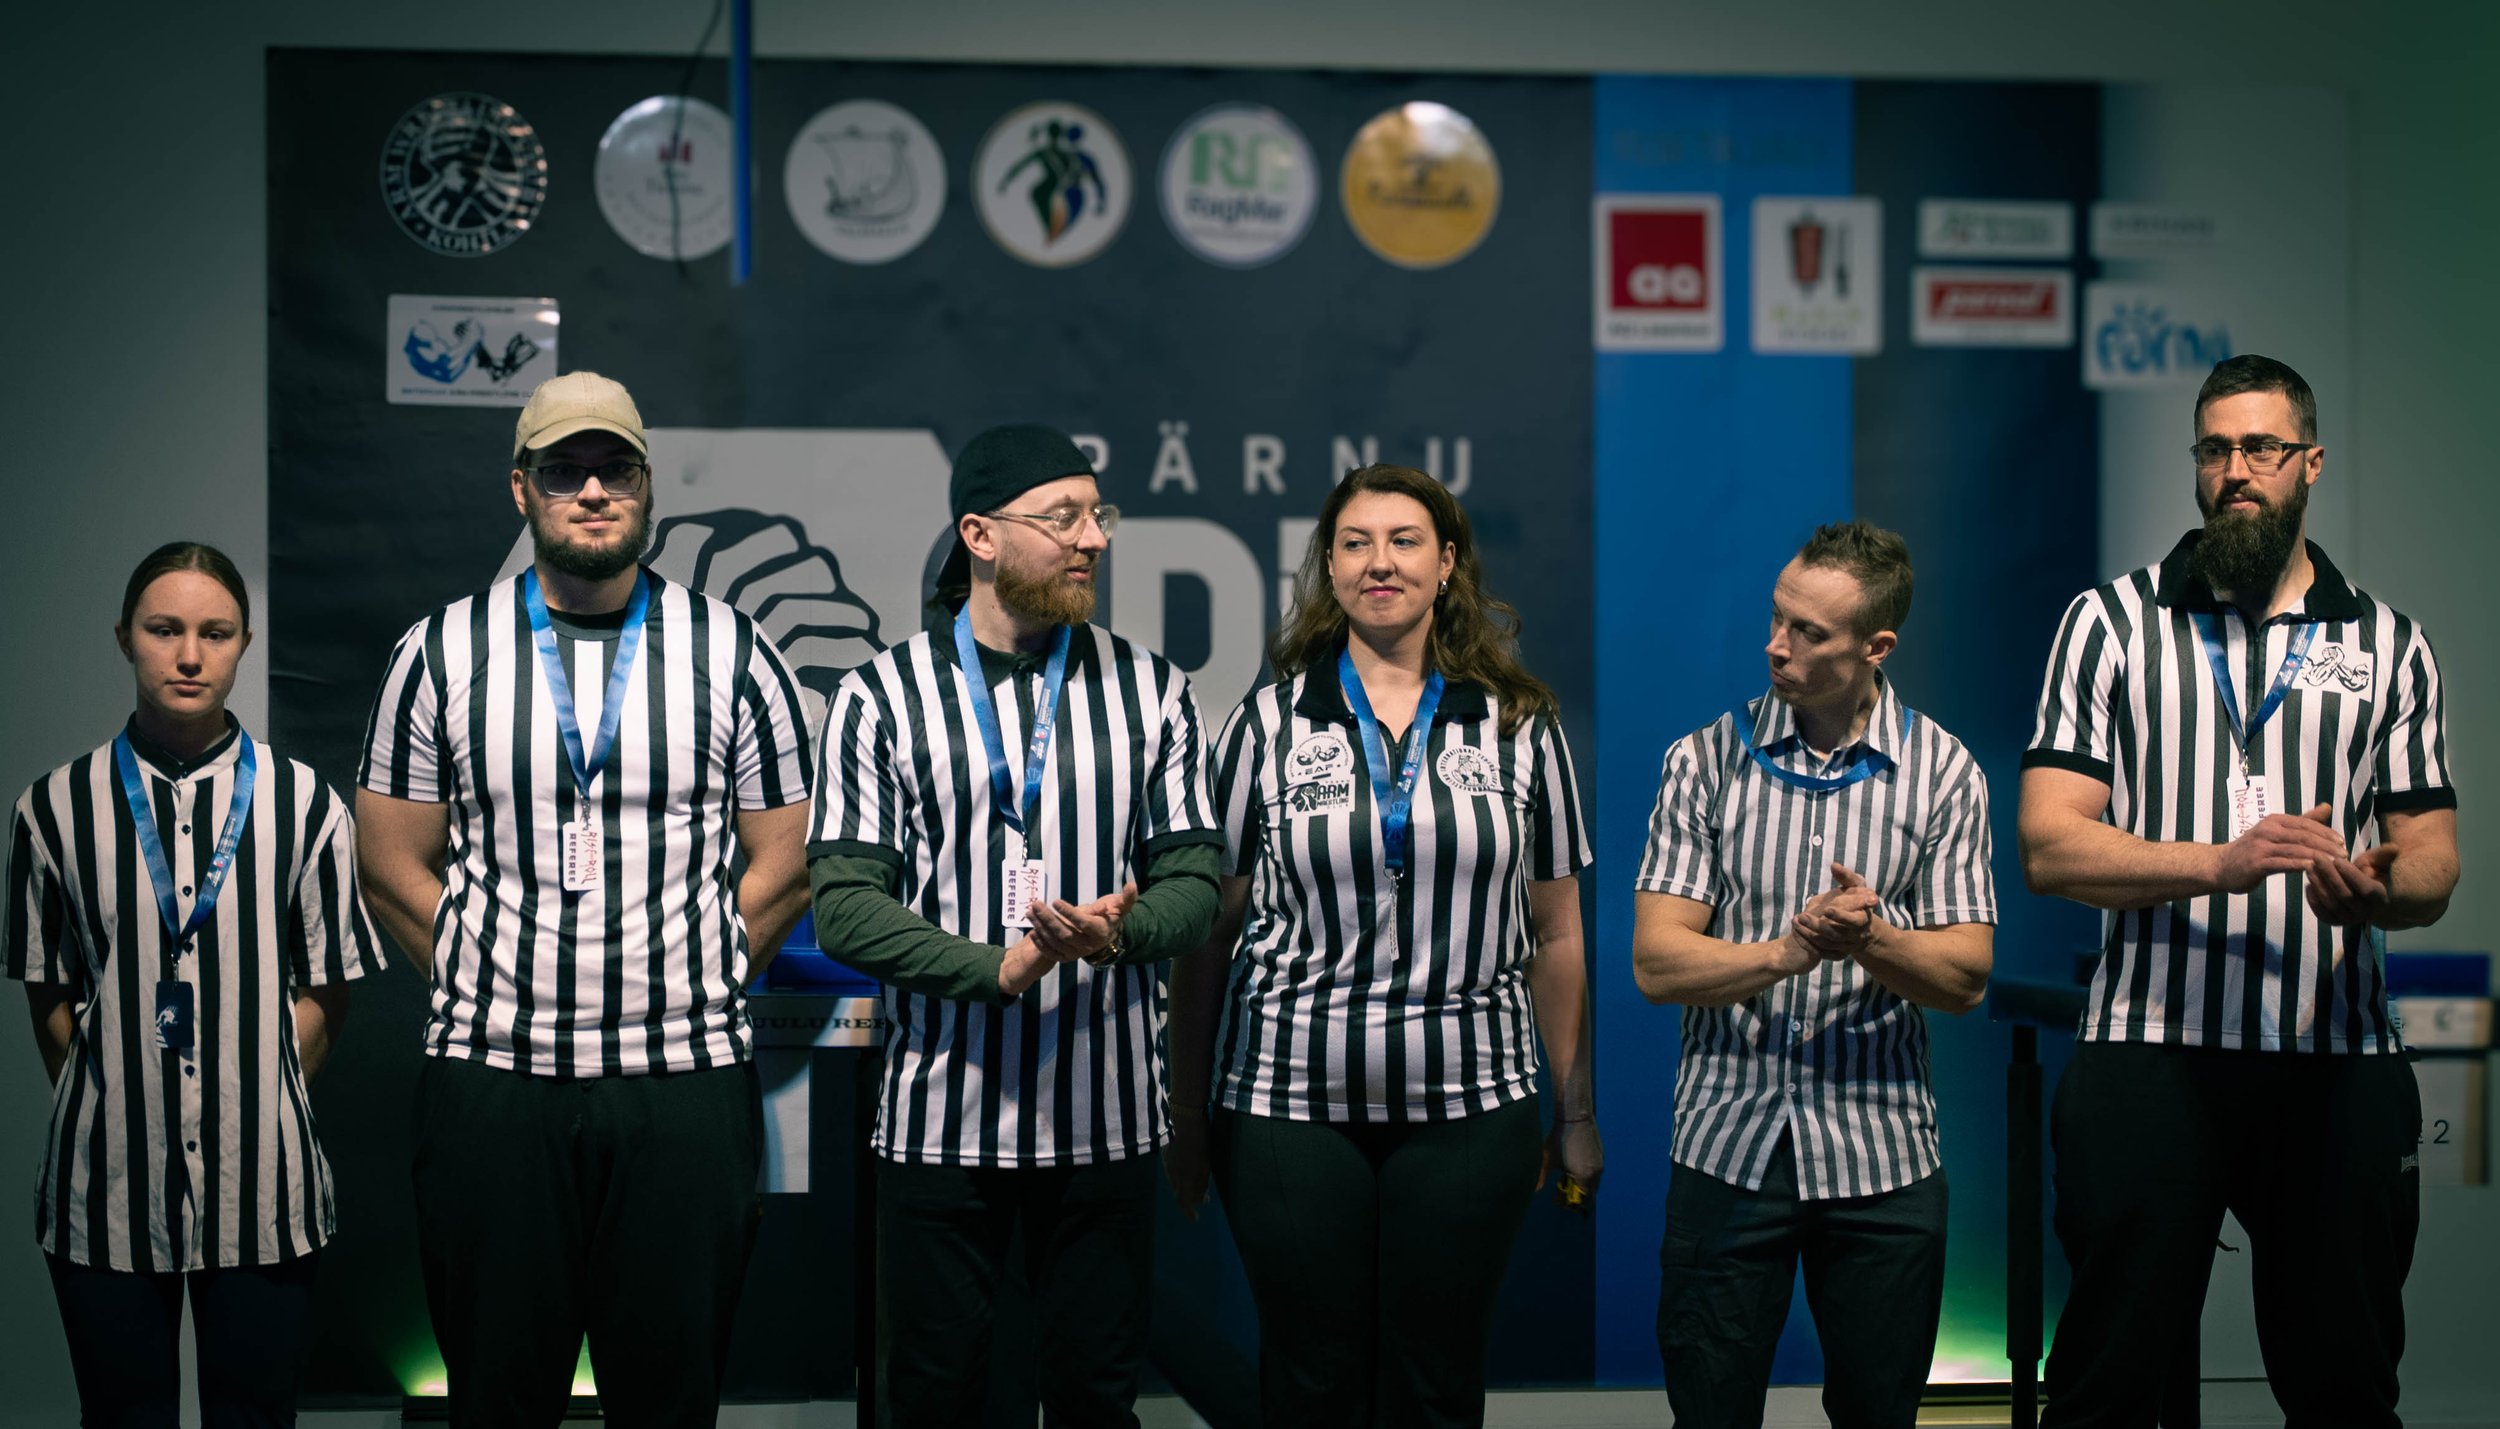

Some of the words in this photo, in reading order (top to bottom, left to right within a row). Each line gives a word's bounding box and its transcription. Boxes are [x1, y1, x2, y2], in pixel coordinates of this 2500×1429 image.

[1304, 764, 1334, 775] EAF
[1317, 783, 1350, 800] ARM
[2255, 786, 2266, 819] FEREE
[568, 833, 577, 883] REFEREE
[1007, 870, 1017, 920] REFEREE
[2433, 1119, 2450, 1144] 2
